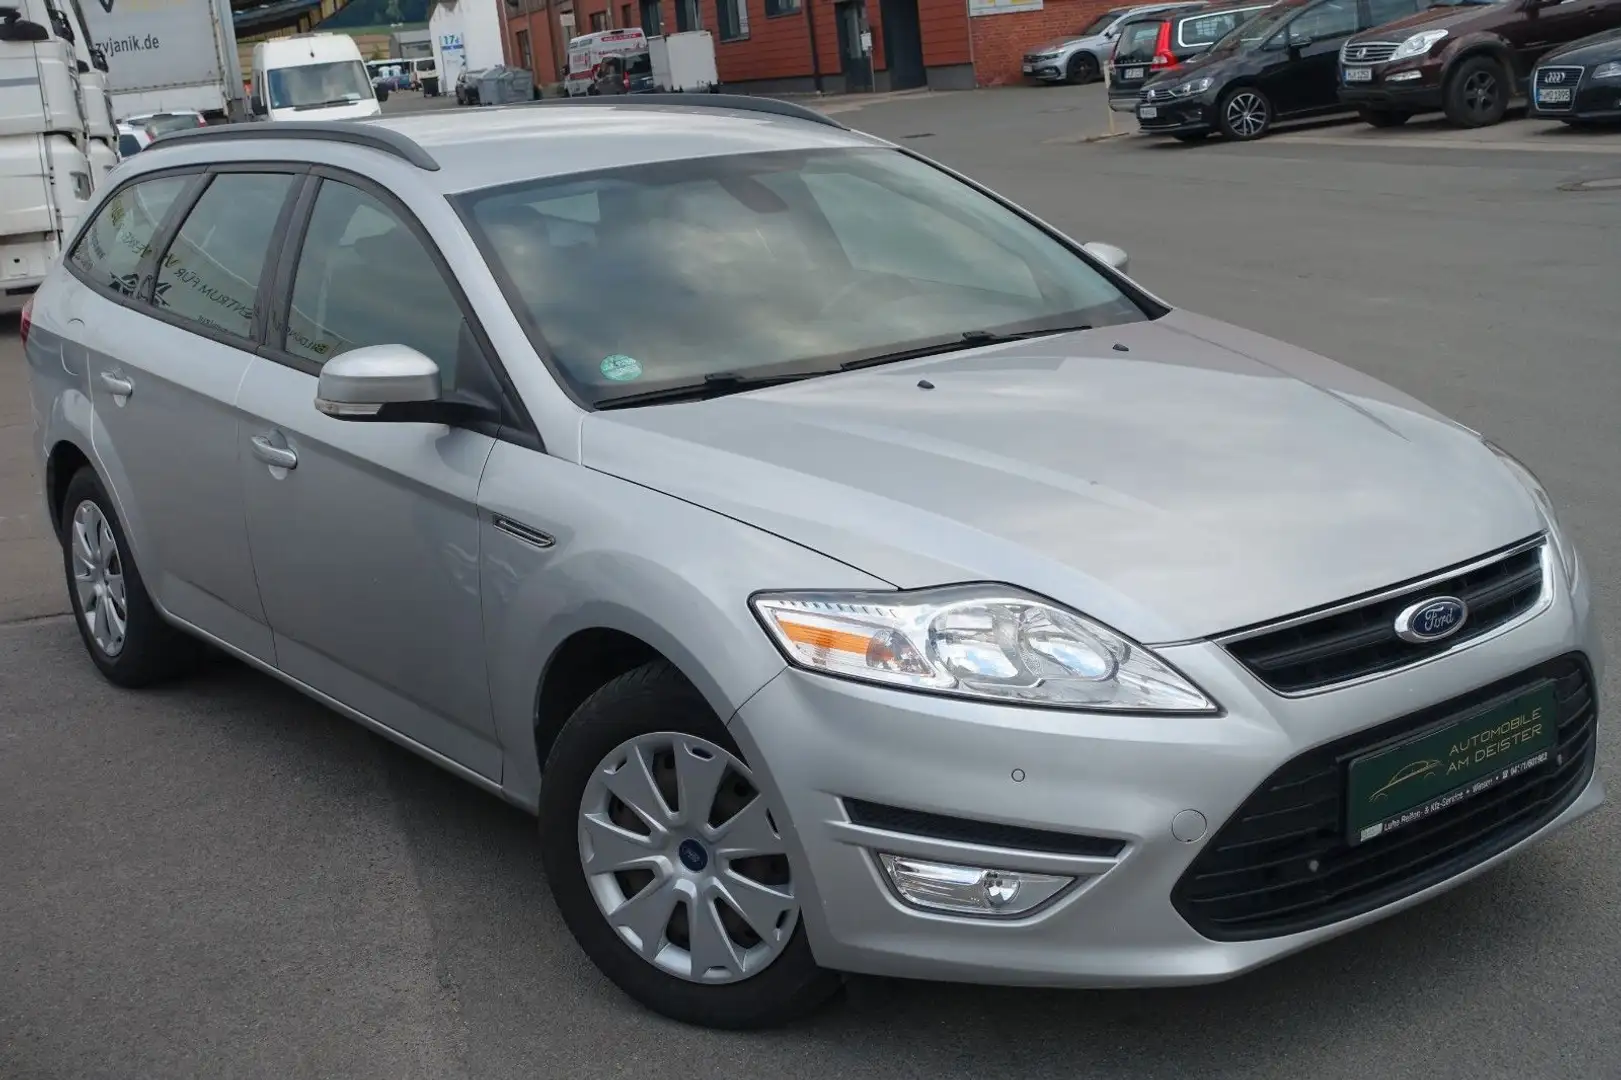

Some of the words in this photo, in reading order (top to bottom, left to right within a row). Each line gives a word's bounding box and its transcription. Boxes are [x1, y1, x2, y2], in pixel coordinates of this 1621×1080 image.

[1424, 606, 1454, 632] Ford
[1446, 756, 1470, 776] AM
[1475, 723, 1543, 763] DEISTER
[1449, 707, 1542, 757] AUTOMOBILE
